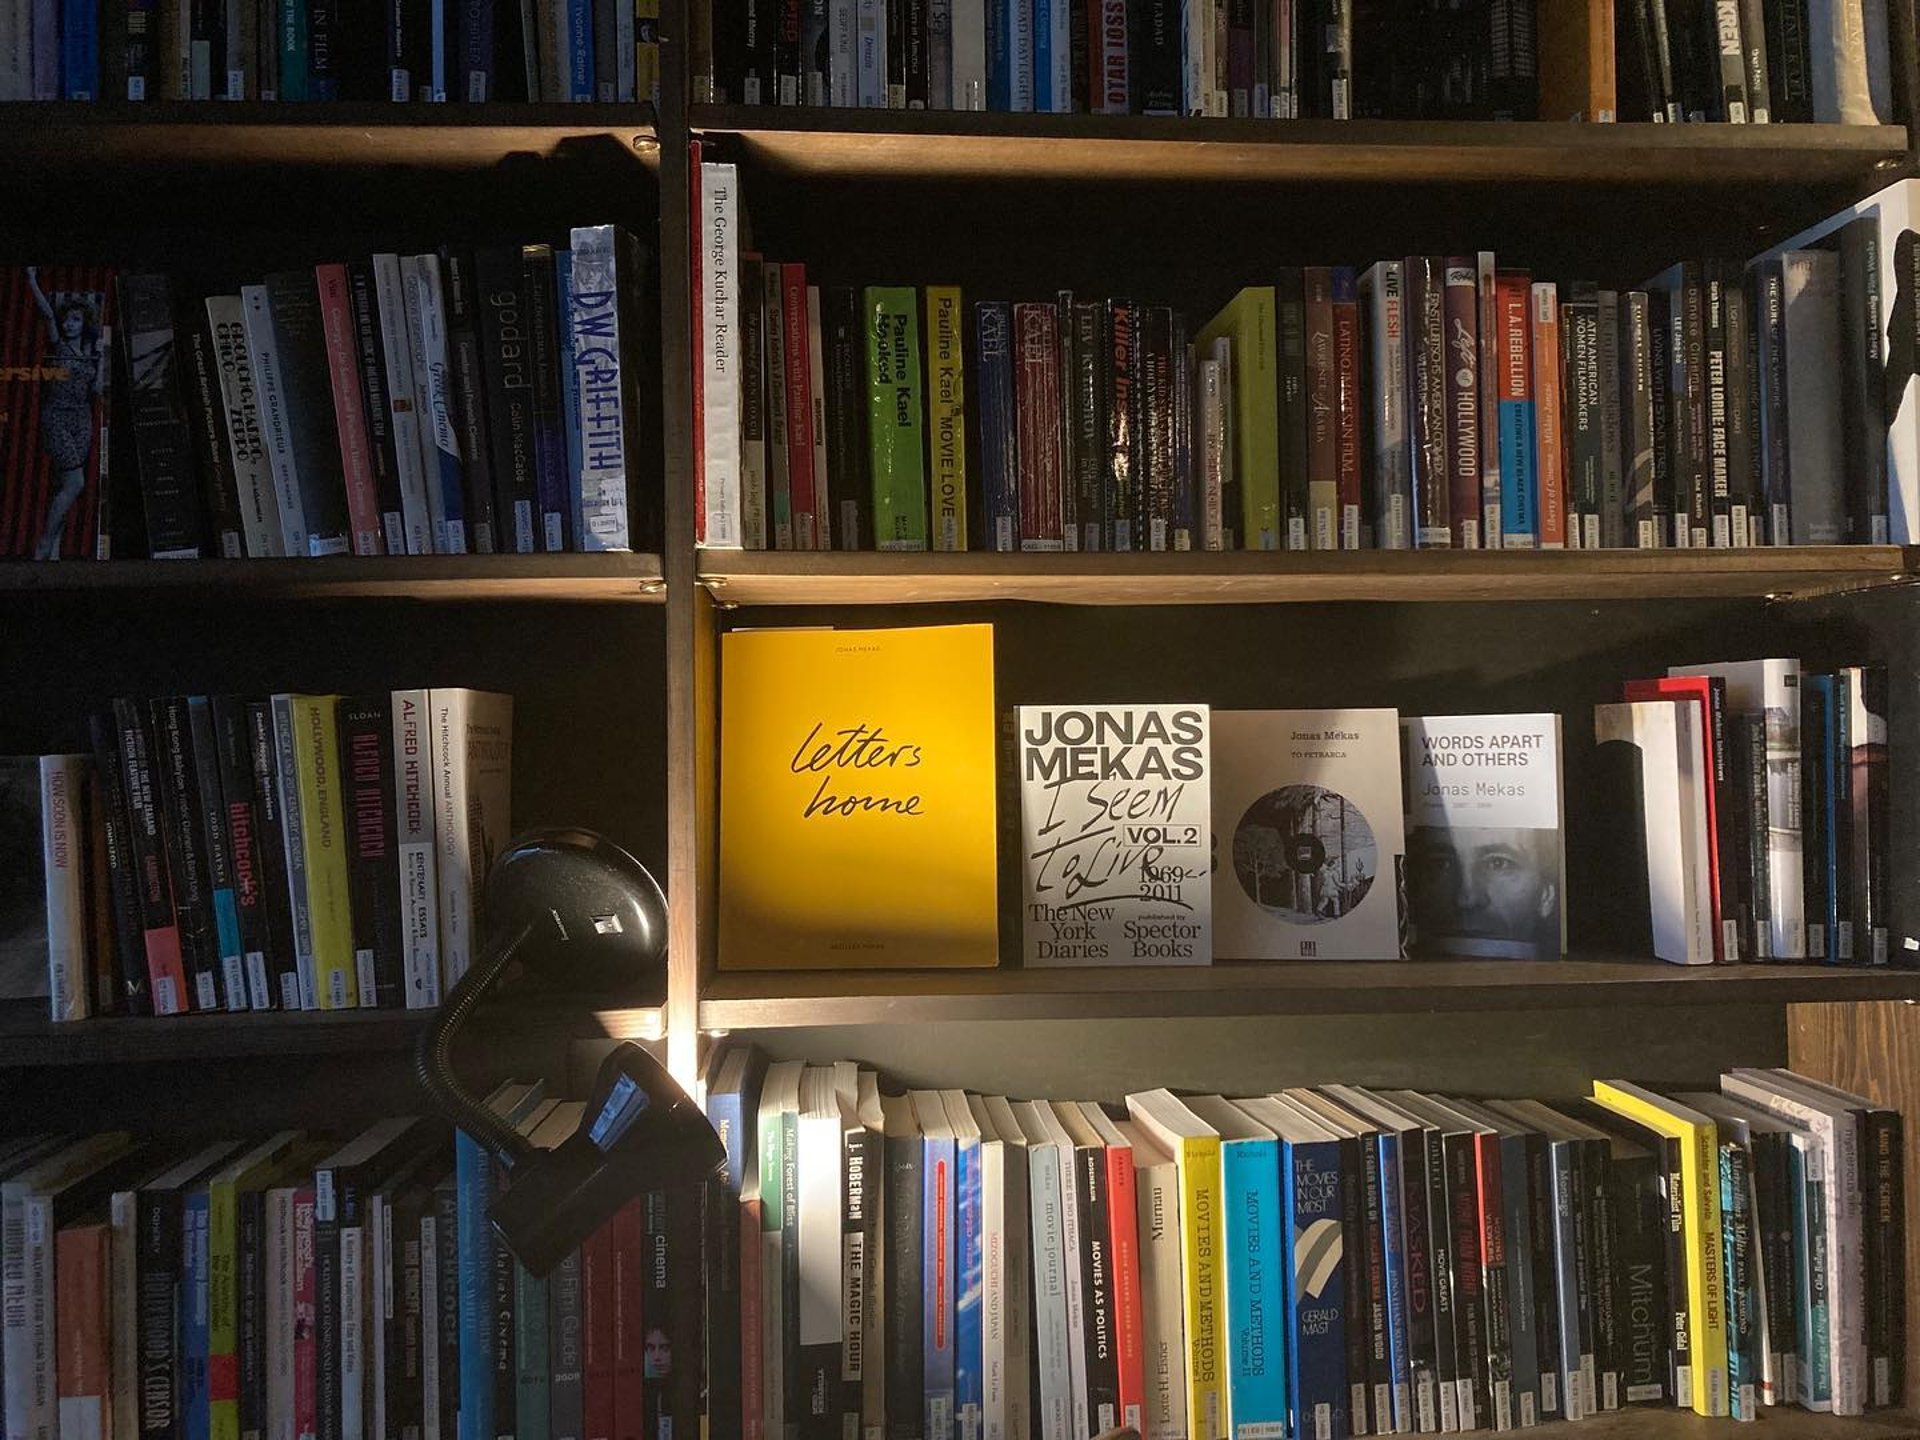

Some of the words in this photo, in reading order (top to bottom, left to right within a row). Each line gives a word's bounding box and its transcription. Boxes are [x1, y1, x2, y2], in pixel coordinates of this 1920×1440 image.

[1717, 1, 1740, 55] KREN
[314, 34, 327, 70] FILM
[1107, 56, 1126, 103] OTAR
[713, 187, 728, 213] The
[711, 216, 728, 266] George
[713, 269, 728, 321] Kuchar
[1386, 271, 1398, 297] LIVE
[1770, 276, 1778, 298] THE
[788, 287, 800, 357] Conversations
[1387, 300, 1399, 339] FLESH
[1430, 292, 1439, 322] ERNST
[938, 297, 952, 360] Pauline
[980, 307, 997, 363] KAEL
[1024, 309, 1042, 363] KAEL
[1080, 315, 1093, 344] LEV
[1113, 308, 1128, 372] Killer
[1340, 320, 1352, 368] LATINO
[1577, 314, 1587, 358] WOMEN
[1586, 314, 1596, 345] LATIN
[491, 291, 528, 389] godard
[511, 403, 523, 431] Colin
[713, 323, 729, 373] Reader
[894, 314, 909, 380] Pauline
[1509, 329, 1525, 396] REBELLION
[791, 359, 803, 381] with
[940, 367, 954, 404] Kael
[1587, 347, 1598, 405] AMERICAN
[1710, 351, 1723, 385] PETER
[576, 347, 622, 470] GRIFFITH
[793, 384, 804, 420] Pauline
[896, 387, 912, 428] Kael
[1432, 376, 1443, 430] AMERICAN
[1577, 360, 1588, 431] FILMMAKERS
[794, 424, 806, 446] Kael
[941, 416, 955, 468] MOVIE
[1457, 391, 1476, 477] HOLLYWOOD
[1712, 427, 1726, 455] FACE
[1342, 443, 1354, 472] FILM
[1714, 457, 1727, 498] MAKER
[941, 474, 955, 517] LOVE
[167, 705, 179, 729] Hong
[255, 711, 265, 740] Dennis
[403, 700, 418, 756] ALFRED
[440, 707, 449, 724] The
[1024, 711, 1204, 746] JONAS
[170, 730, 182, 754] Kong
[310, 707, 325, 788] HOLLYWOOD,
[441, 724, 451, 769] Hitchcock
[791, 722, 922, 774] letters
[1290, 731, 1321, 741] Jonas
[1324, 731, 1360, 741] Mekas
[1421, 735, 1484, 750] WORDS
[1488, 734, 1544, 749] APART
[173, 755, 186, 790] Babylon
[1025, 746, 1204, 781] MEKAS
[1422, 753, 1459, 767] AND
[1463, 752, 1528, 767] OTHERS
[52, 771, 64, 799] HOW
[405, 760, 421, 835] HITCHCOCK
[443, 769, 452, 799] Annual
[804, 775, 925, 820] home
[1422, 783, 1470, 797] Jonas
[1475, 783, 1526, 796] Mekas
[53, 799, 65, 829] SOON
[210, 811, 220, 840] TODD
[317, 789, 331, 848] ENGLAND
[445, 800, 455, 859] ANTHOLOGY
[53, 830, 65, 841] IS
[1127, 827, 1180, 844] VOL.
[1184, 828, 1198, 844] 2
[55, 842, 67, 868] NOW
[418, 906, 428, 939] ESSAYS
[1028, 904, 1068, 922] The
[1072, 904, 1116, 922] New
[1051, 923, 1097, 940] York
[1123, 921, 1201, 943] Spector
[1133, 940, 1193, 958] Books
[1037, 941, 1110, 959] Diaries
[1364, 1137, 1374, 1153] THE
[786, 1162, 796, 1191] Forest
[1064, 1161, 1074, 1191] THERE
[1087, 1156, 1096, 1202] ROSENBAUM
[1295, 1158, 1315, 1171] THE
[1296, 1171, 1338, 1187] MOVIES
[1365, 1154, 1376, 1183] FABER
[1880, 1160, 1890, 1178] THE
[786, 1192, 796, 1203] of
[1367, 1184, 1377, 1209] BOOK
[1559, 1169, 1570, 1217] Montage
[1670, 1172, 1680, 1212] Materialist
[1880, 1182, 1890, 1223] SCREEN
[786, 1204, 797, 1227] Bliss
[1045, 1202, 1058, 1243] movie
[1151, 1187, 1164, 1241] Murnau
[1195, 1188, 1211, 1258] MOVIES
[1245, 1190, 1262, 1254] MOVIES
[1671, 1214, 1682, 1232] Film
[1065, 1218, 1076, 1252] ITHACA
[655, 1235, 668, 1289] cinema
[849, 1242, 862, 1271] THE
[989, 1231, 998, 1288] MIZOGUCHI
[1045, 1246, 1061, 1297] journal
[1090, 1240, 1102, 1287] MOVIES
[1436, 1248, 1447, 1277] MOVIE
[1704, 1232, 1716, 1282] MASTERS
[1197, 1261, 1211, 1297] AND
[1248, 1257, 1263, 1294] AND
[1707, 1284, 1717, 1299] OF
[562, 1278, 578, 1312] Film
[849, 1276, 861, 1325] MAGIC
[1093, 1289, 1104, 1306] AS
[1438, 1278, 1449, 1313] GREATS
[989, 1311, 999, 1340] JAPAN
[1301, 1307, 1339, 1323] GERALD
[1302, 1320, 1329, 1336] MAST
[1373, 1302, 1382, 1331] JASON
[1628, 1263, 1655, 1384] Mitchum
[1675, 1312, 1686, 1330] Peter
[1708, 1301, 1719, 1330] LIGHT
[562, 1315, 579, 1366] Guide
[849, 1330, 861, 1372] HOUR
[1095, 1309, 1107, 1360] POLITICS
[1199, 1299, 1214, 1383] METHODS
[1240, 1326, 1251, 1365] Volume
[1249, 1299, 1265, 1377] METHODS
[1374, 1333, 1383, 1360] WOOD
[1676, 1331, 1688, 1350] Gidal
[1158, 1341, 1169, 1374] Eisner
[145, 1376, 172, 1429] CENSOR
[1159, 1389, 1170, 1424] Lotte
